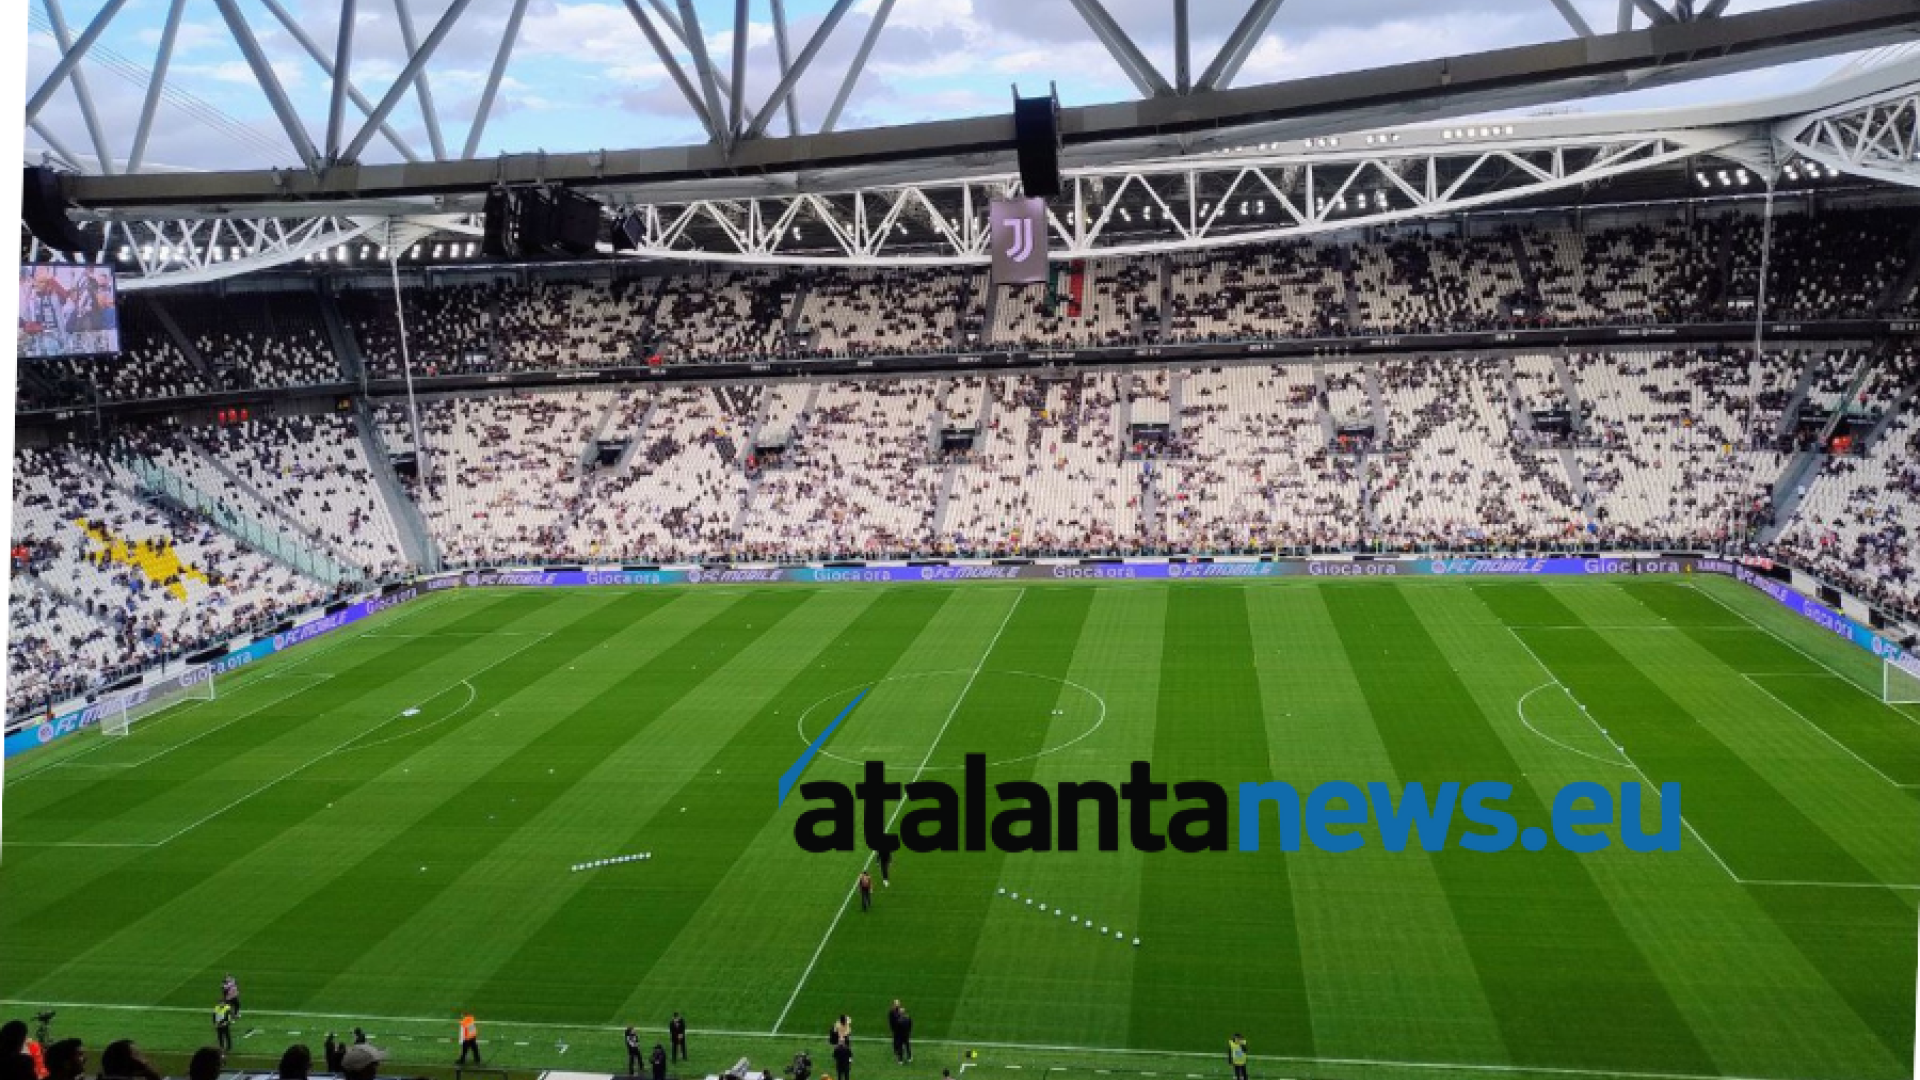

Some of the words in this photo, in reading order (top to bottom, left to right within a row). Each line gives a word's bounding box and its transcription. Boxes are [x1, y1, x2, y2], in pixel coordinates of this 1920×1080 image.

[936, 566, 955, 578] FC
[955, 566, 1021, 578] MOBILE
[1053, 564, 1103, 578] Gioca
[1107, 567, 1136, 578] ora
[1182, 563, 1203, 576] FC
[1203, 563, 1274, 576] MOBILE
[1309, 561, 1361, 575] Gioca
[1366, 563, 1396, 575] ora
[1448, 560, 1469, 572] FC
[1470, 560, 1548, 572] MOBILE
[1647, 562, 1680, 573] ora
[587, 571, 629, 584] Gioca
[635, 573, 660, 584] ora
[720, 569, 783, 582] MOBILE
[814, 568, 860, 581] Gioca
[864, 570, 891, 581] ora
[1803, 600, 1833, 629] Gioca
[1834, 620, 1853, 640] ora
[228, 651, 252, 670] ora
[55, 713, 80, 736] FC
